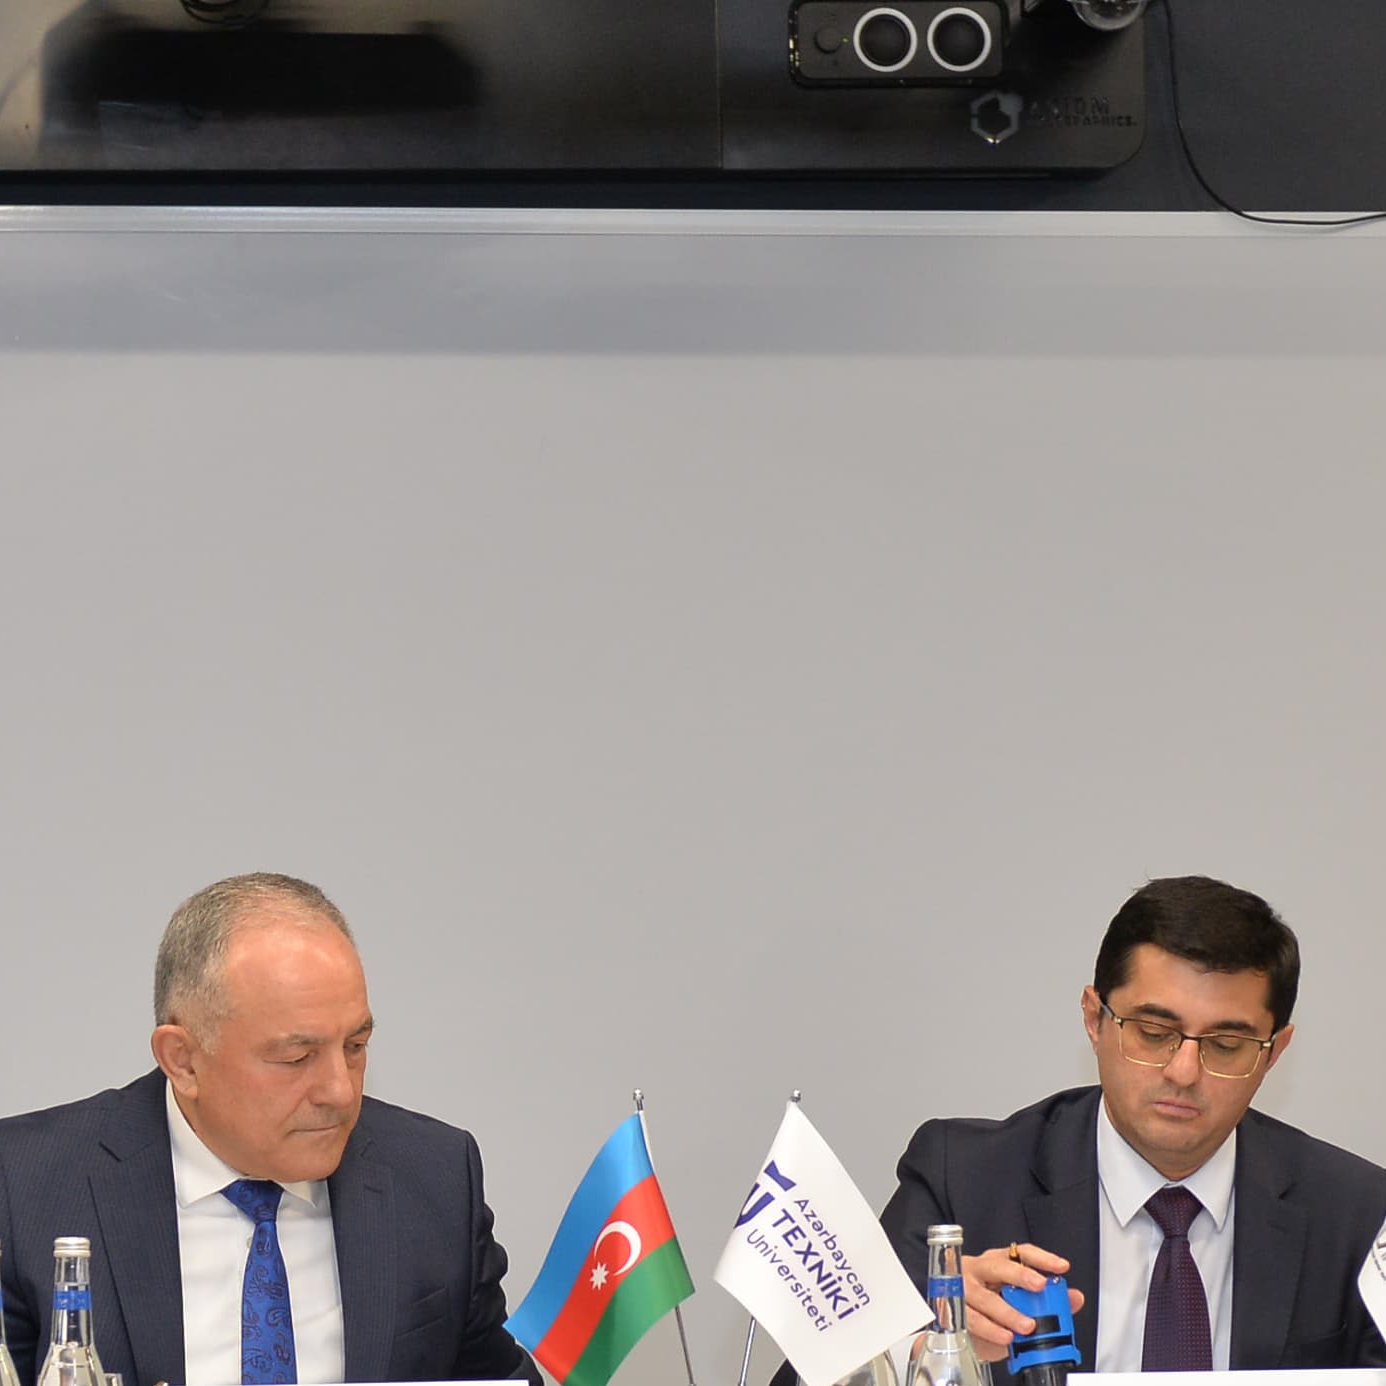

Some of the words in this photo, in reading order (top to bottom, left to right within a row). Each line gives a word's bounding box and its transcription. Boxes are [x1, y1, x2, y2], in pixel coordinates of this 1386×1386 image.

[746, 1228, 833, 1332] Universiteti
[771, 1207, 861, 1320] TEXNİKİ
[793, 1199, 871, 1306] Azərbaycan
